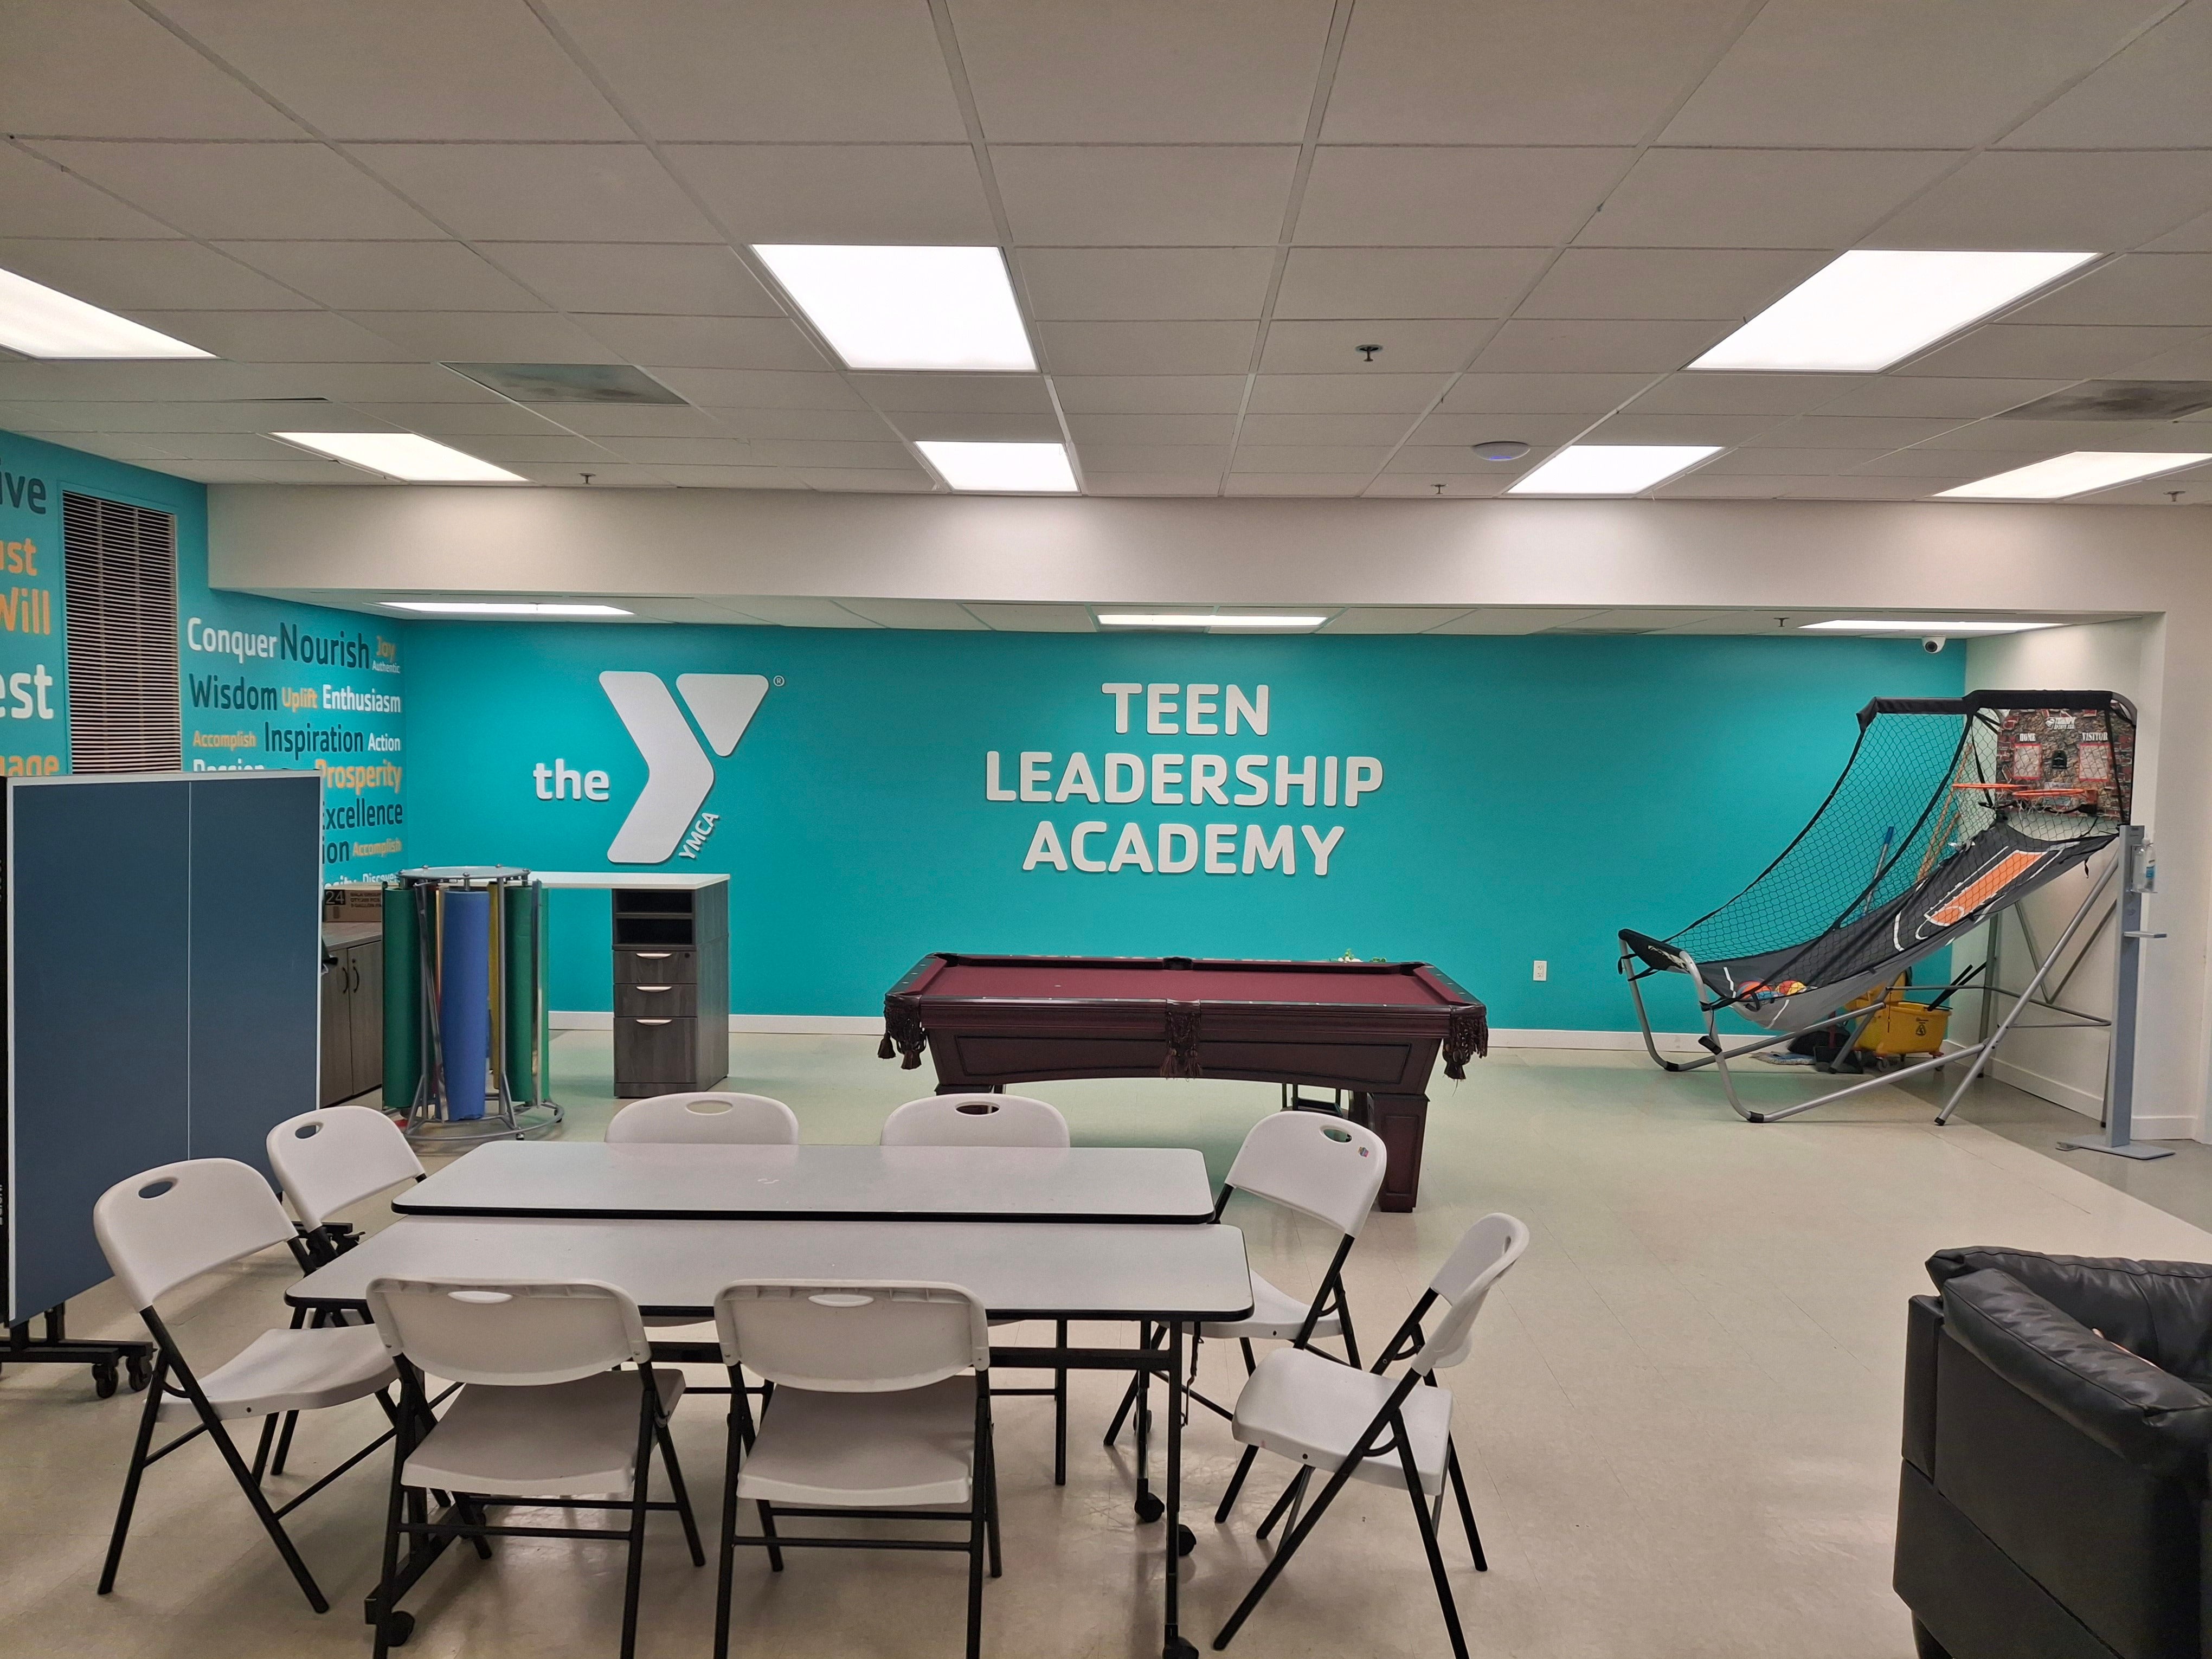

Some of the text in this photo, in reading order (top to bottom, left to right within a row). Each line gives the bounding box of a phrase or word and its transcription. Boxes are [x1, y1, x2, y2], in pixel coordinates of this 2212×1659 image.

[187, 617, 396, 669] Conquer Nourish Joy
[372, 660, 401, 673] Authentic
[0, 664, 53, 719] st
[189, 673, 401, 713] Wisdom Uplift Enthusiasm
[1101, 682, 1269, 736] TEEN
[193, 722, 401, 760] Accomplish Inspiration Action
[2019, 732, 2036, 742] HOME
[0, 755, 59, 776] ae
[532, 758, 610, 801] the
[986, 750, 1384, 807] LEADERSHIP
[323, 798, 403, 829] xcellence
[678, 812, 720, 859] YMCA
[1022, 820, 1345, 877] ACADEMY
[325, 890, 345, 905] 24
